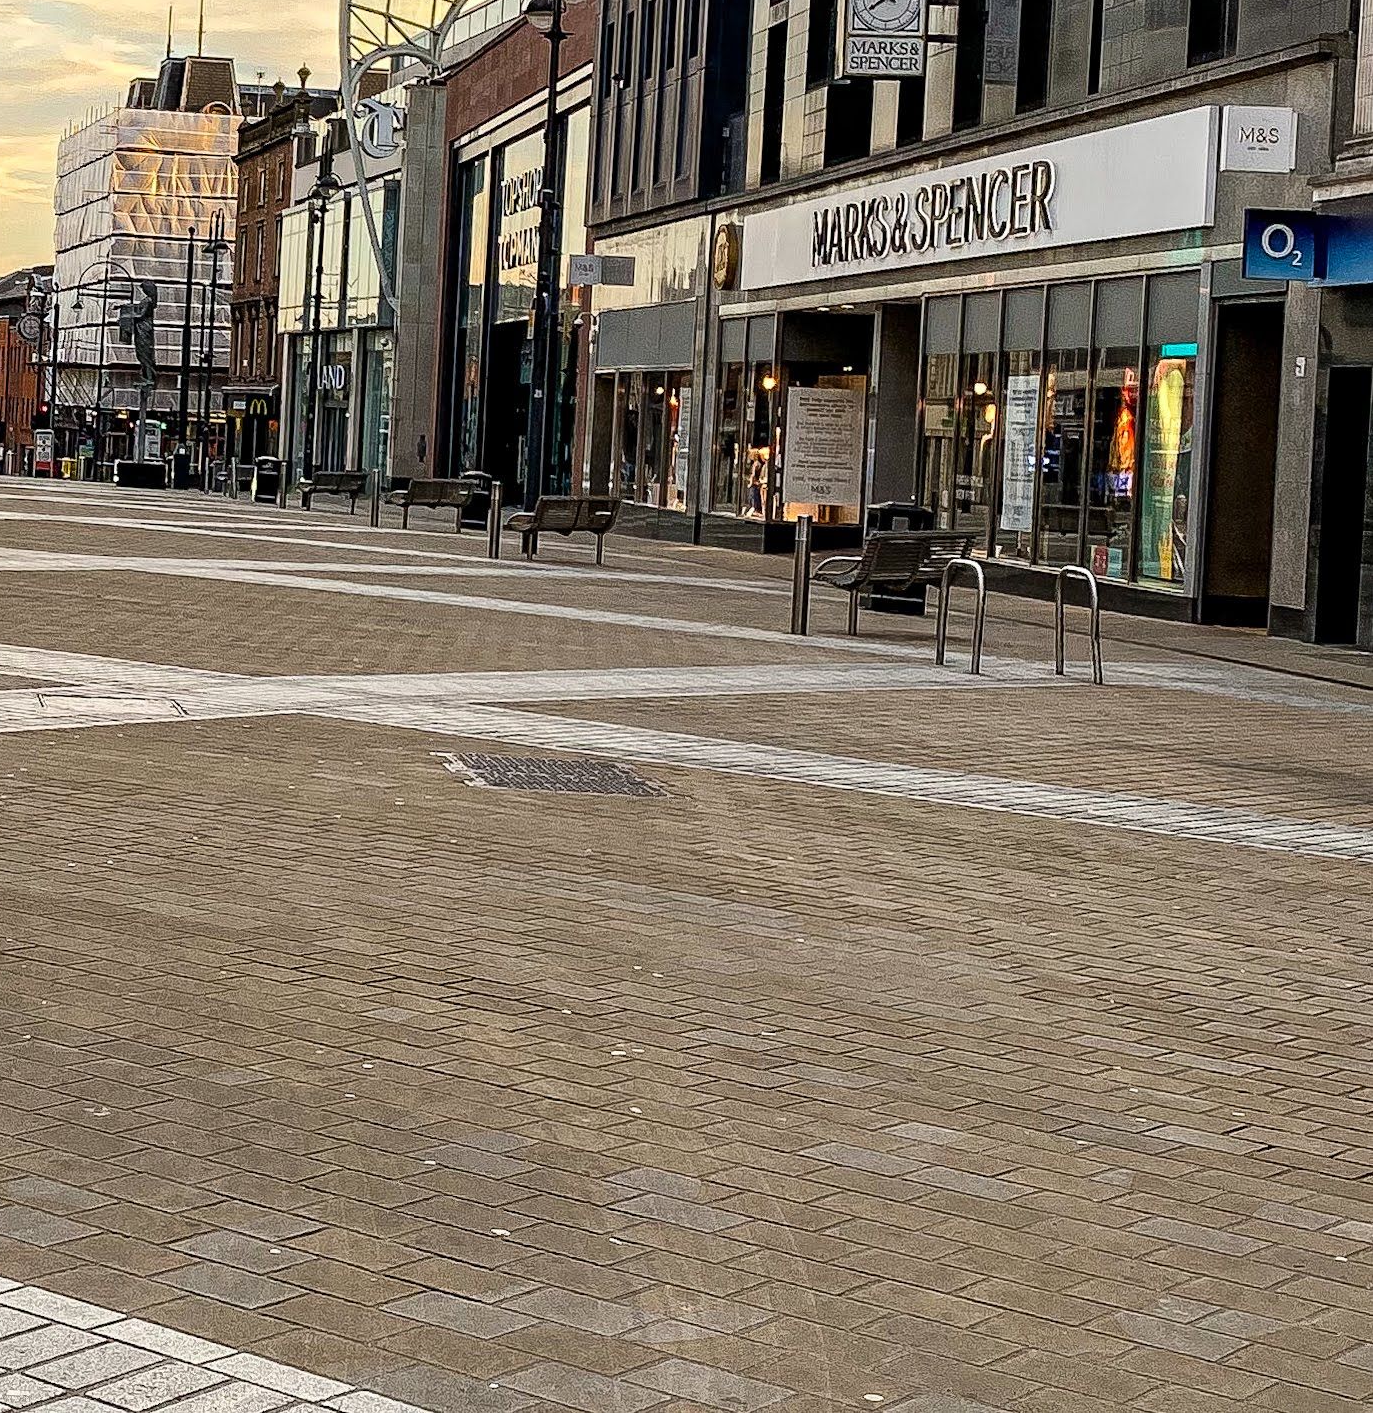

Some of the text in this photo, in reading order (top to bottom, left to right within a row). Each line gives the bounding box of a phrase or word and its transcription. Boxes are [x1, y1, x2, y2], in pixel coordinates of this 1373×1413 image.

[849, 56, 920, 71] SPENCER
[1239, 126, 1280, 144] M&S
[501, 166, 544, 217] TOPSHOP
[498, 226, 540, 270] TOPMAN
